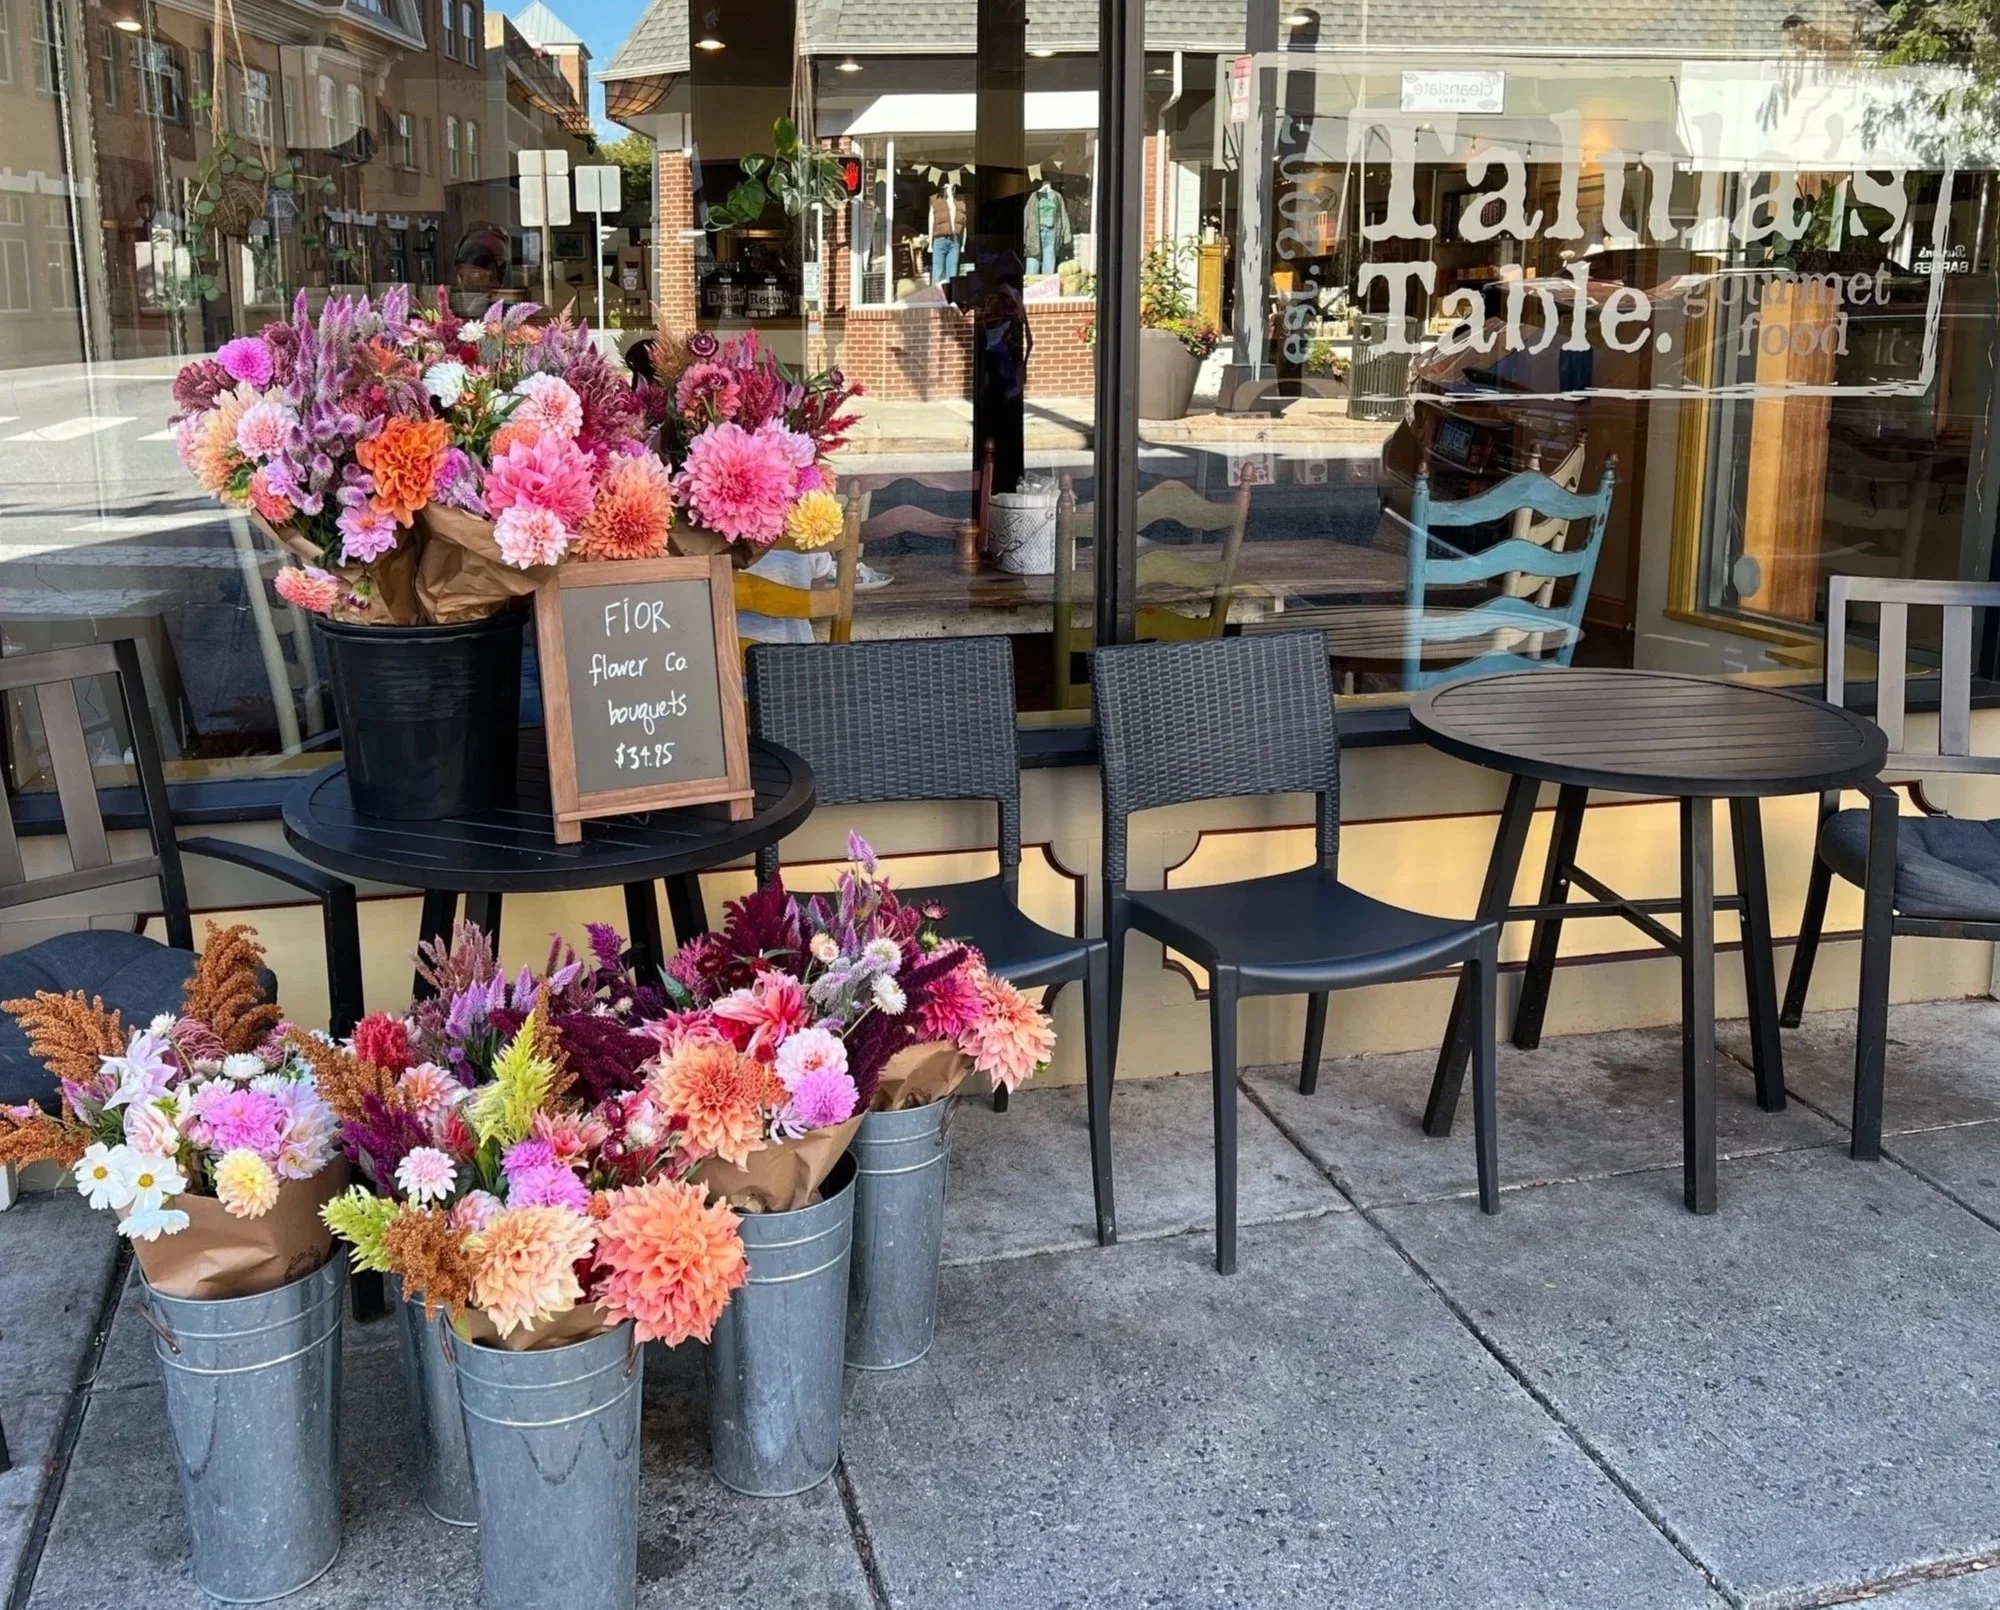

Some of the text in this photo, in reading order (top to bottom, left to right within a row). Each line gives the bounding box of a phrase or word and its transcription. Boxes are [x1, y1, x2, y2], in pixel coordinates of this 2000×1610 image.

[1346, 107, 1908, 243] Talula's
[1357, 260, 1672, 355] Table.
[1682, 262, 1892, 318] gourmet
[1737, 311, 1849, 357] food
[588, 653, 648, 687] flower
[607, 690, 687, 735] bouquets
[614, 742, 676, 769] $34.95
